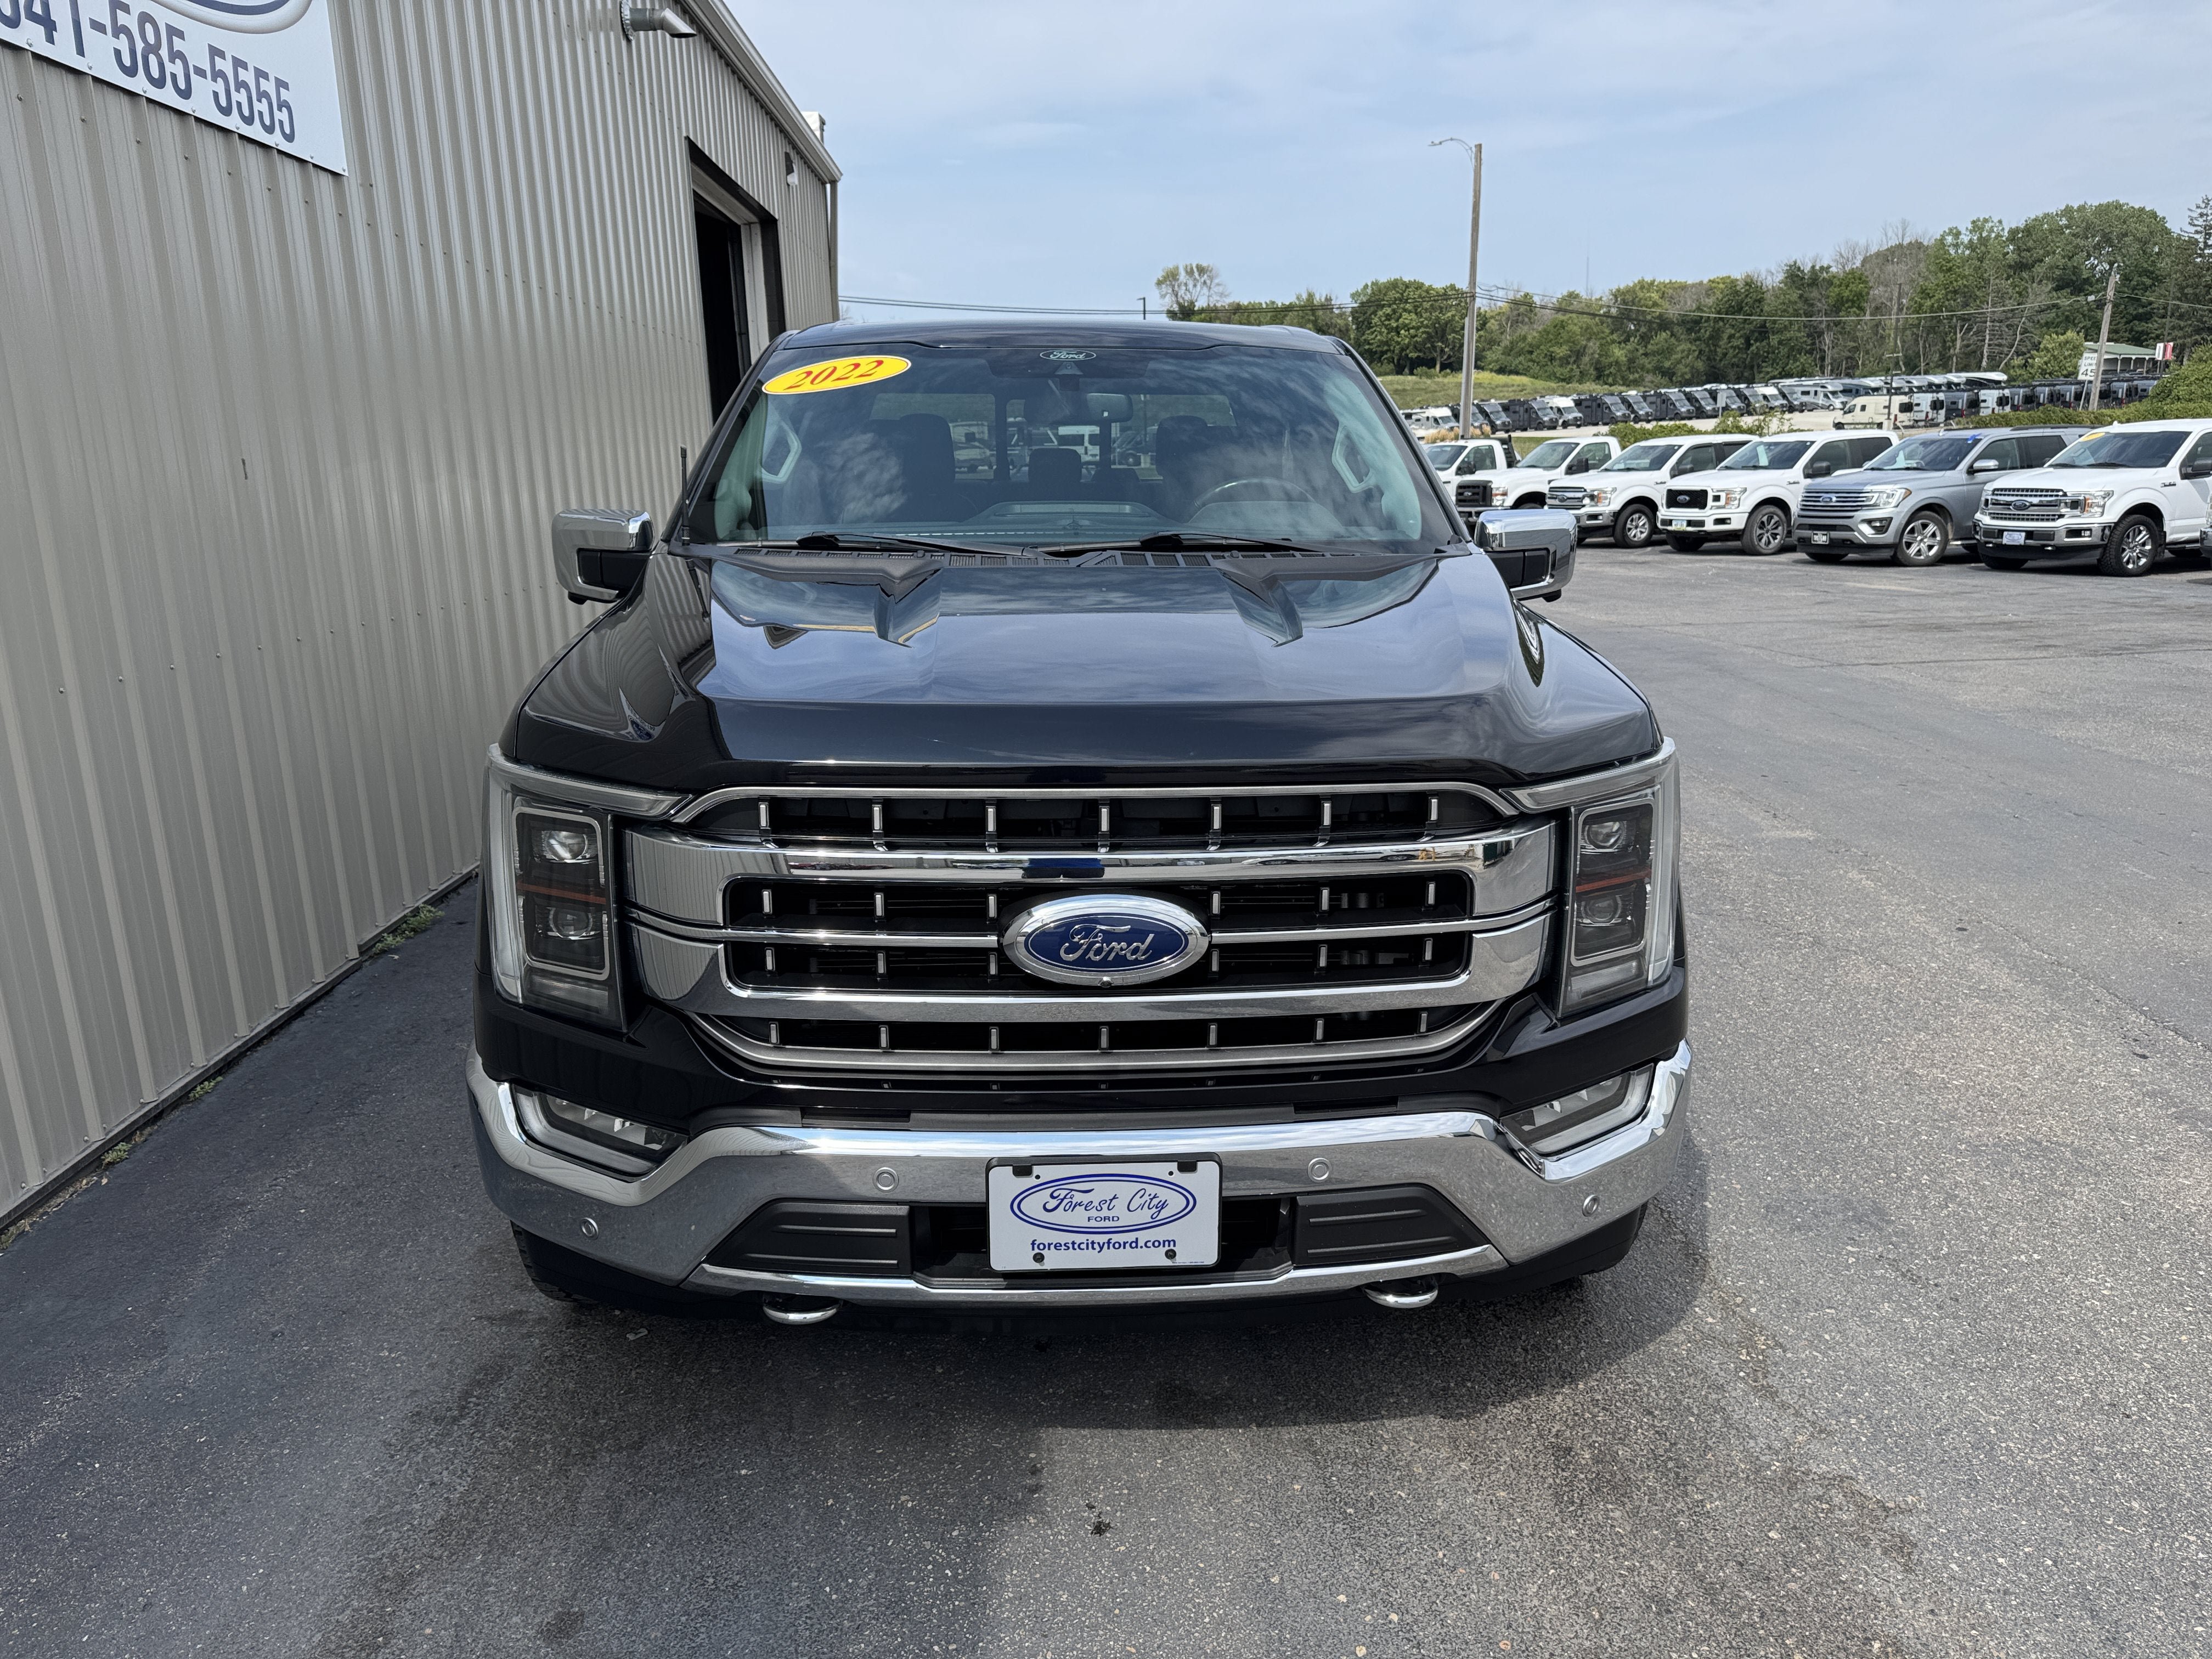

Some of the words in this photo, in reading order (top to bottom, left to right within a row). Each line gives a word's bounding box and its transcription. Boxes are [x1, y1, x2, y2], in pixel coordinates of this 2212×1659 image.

[1049, 351, 1086, 359] Ford
[782, 359, 884, 391] 2022
[2081, 369, 2096, 377] 45
[1059, 923, 1155, 961] Ford
[1042, 1188, 1119, 1212] Forest
[1126, 1188, 1169, 1220] City
[1030, 1237, 1177, 1254] forestcityford.com
